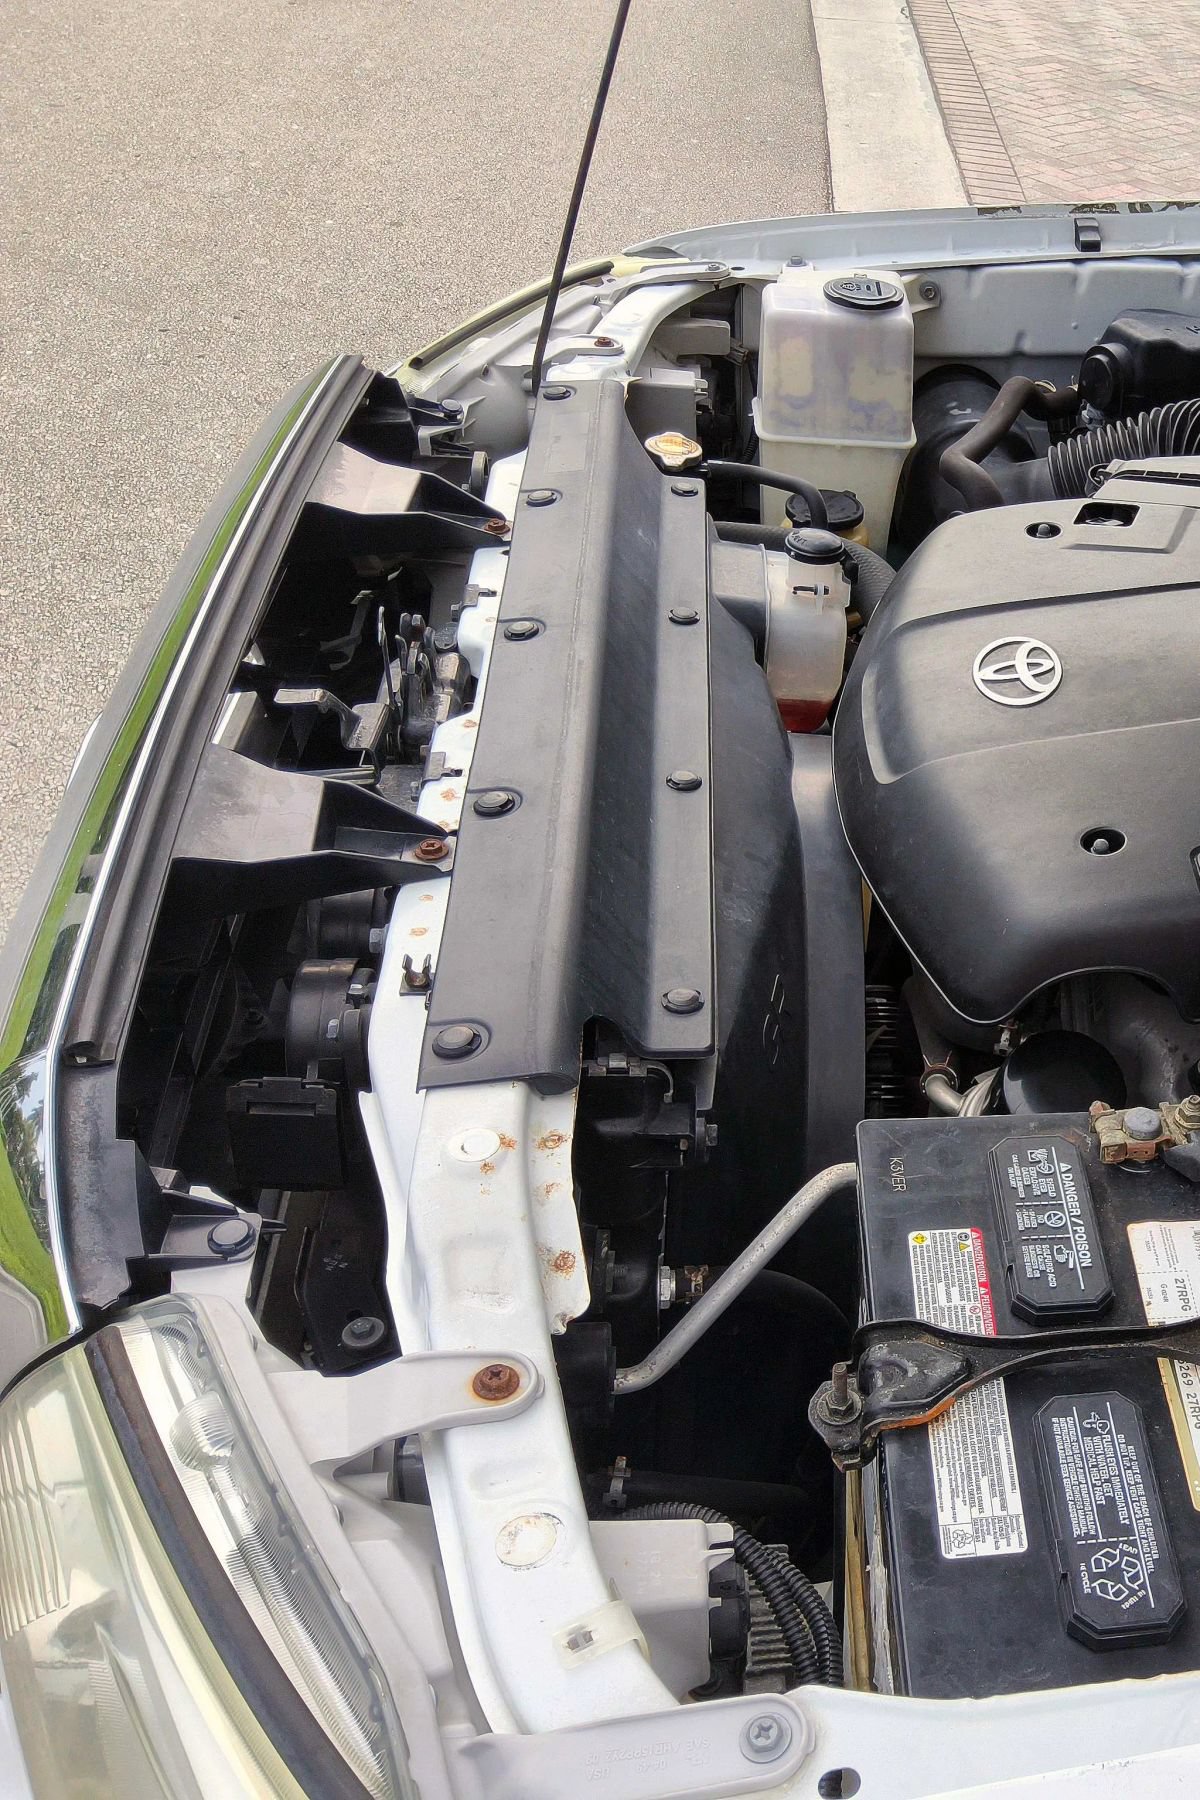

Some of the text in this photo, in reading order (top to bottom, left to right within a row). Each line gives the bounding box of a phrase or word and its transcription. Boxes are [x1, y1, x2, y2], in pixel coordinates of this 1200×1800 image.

[889, 1157, 907, 1192] K3VER
[1029, 1167, 1041, 1195] EXPLOSIVE
[1039, 1178, 1047, 1192] EYES
[1046, 1178, 1056, 1197] SHIELD
[1022, 1210, 1031, 1227] FLAMES
[1037, 1215, 1044, 1223] NO
[1062, 1174, 1080, 1215] DANGER
[1073, 1226, 1091, 1266] POISON
[1048, 1273, 1057, 1287] ACID
[1172, 1277, 1192, 1311] 27RPG
[1053, 1424, 1061, 1434] NOT
[1117, 1434, 1125, 1443] DO
[1055, 1435, 1066, 1463] AVAILABLE
[1057, 1418, 1072, 1455] INSTRUCTIONS
[1068, 1463, 1078, 1485] VEHICLE
[1072, 1442, 1080, 1453] FOR
[1120, 1444, 1128, 1455] NOT
[1074, 1454, 1083, 1467] SAFE
[1093, 1436, 1113, 1497] WITH WATER. GET
[1060, 1464, 1069, 1478] SEEK
[1077, 1468, 1086, 1483] JUMP
[1084, 1437, 1105, 1505] MEDICAL HELP FAST
[1102, 1435, 1129, 1524] FLUSH EYES IMMEDIATELY
[1126, 1470, 1134, 1484] KEEP
[1063, 1478, 1074, 1500] SERVICE
[1080, 1484, 1091, 1510] STARTING
[1128, 1485, 1138, 1501] VENT
[1127, 1446, 1159, 1559] KEEP OUT OF THE REACH OF CHILDREN
[1133, 1502, 1143, 1518] CAPS
[1068, 1501, 1080, 1537] ASSISTANCE.
[1086, 1511, 1096, 1534] FOLLOW
[1137, 1520, 1147, 1537] TIGHT
[1119, 1543, 1138, 1554] LEAD
[1141, 1539, 1150, 1552] AND
